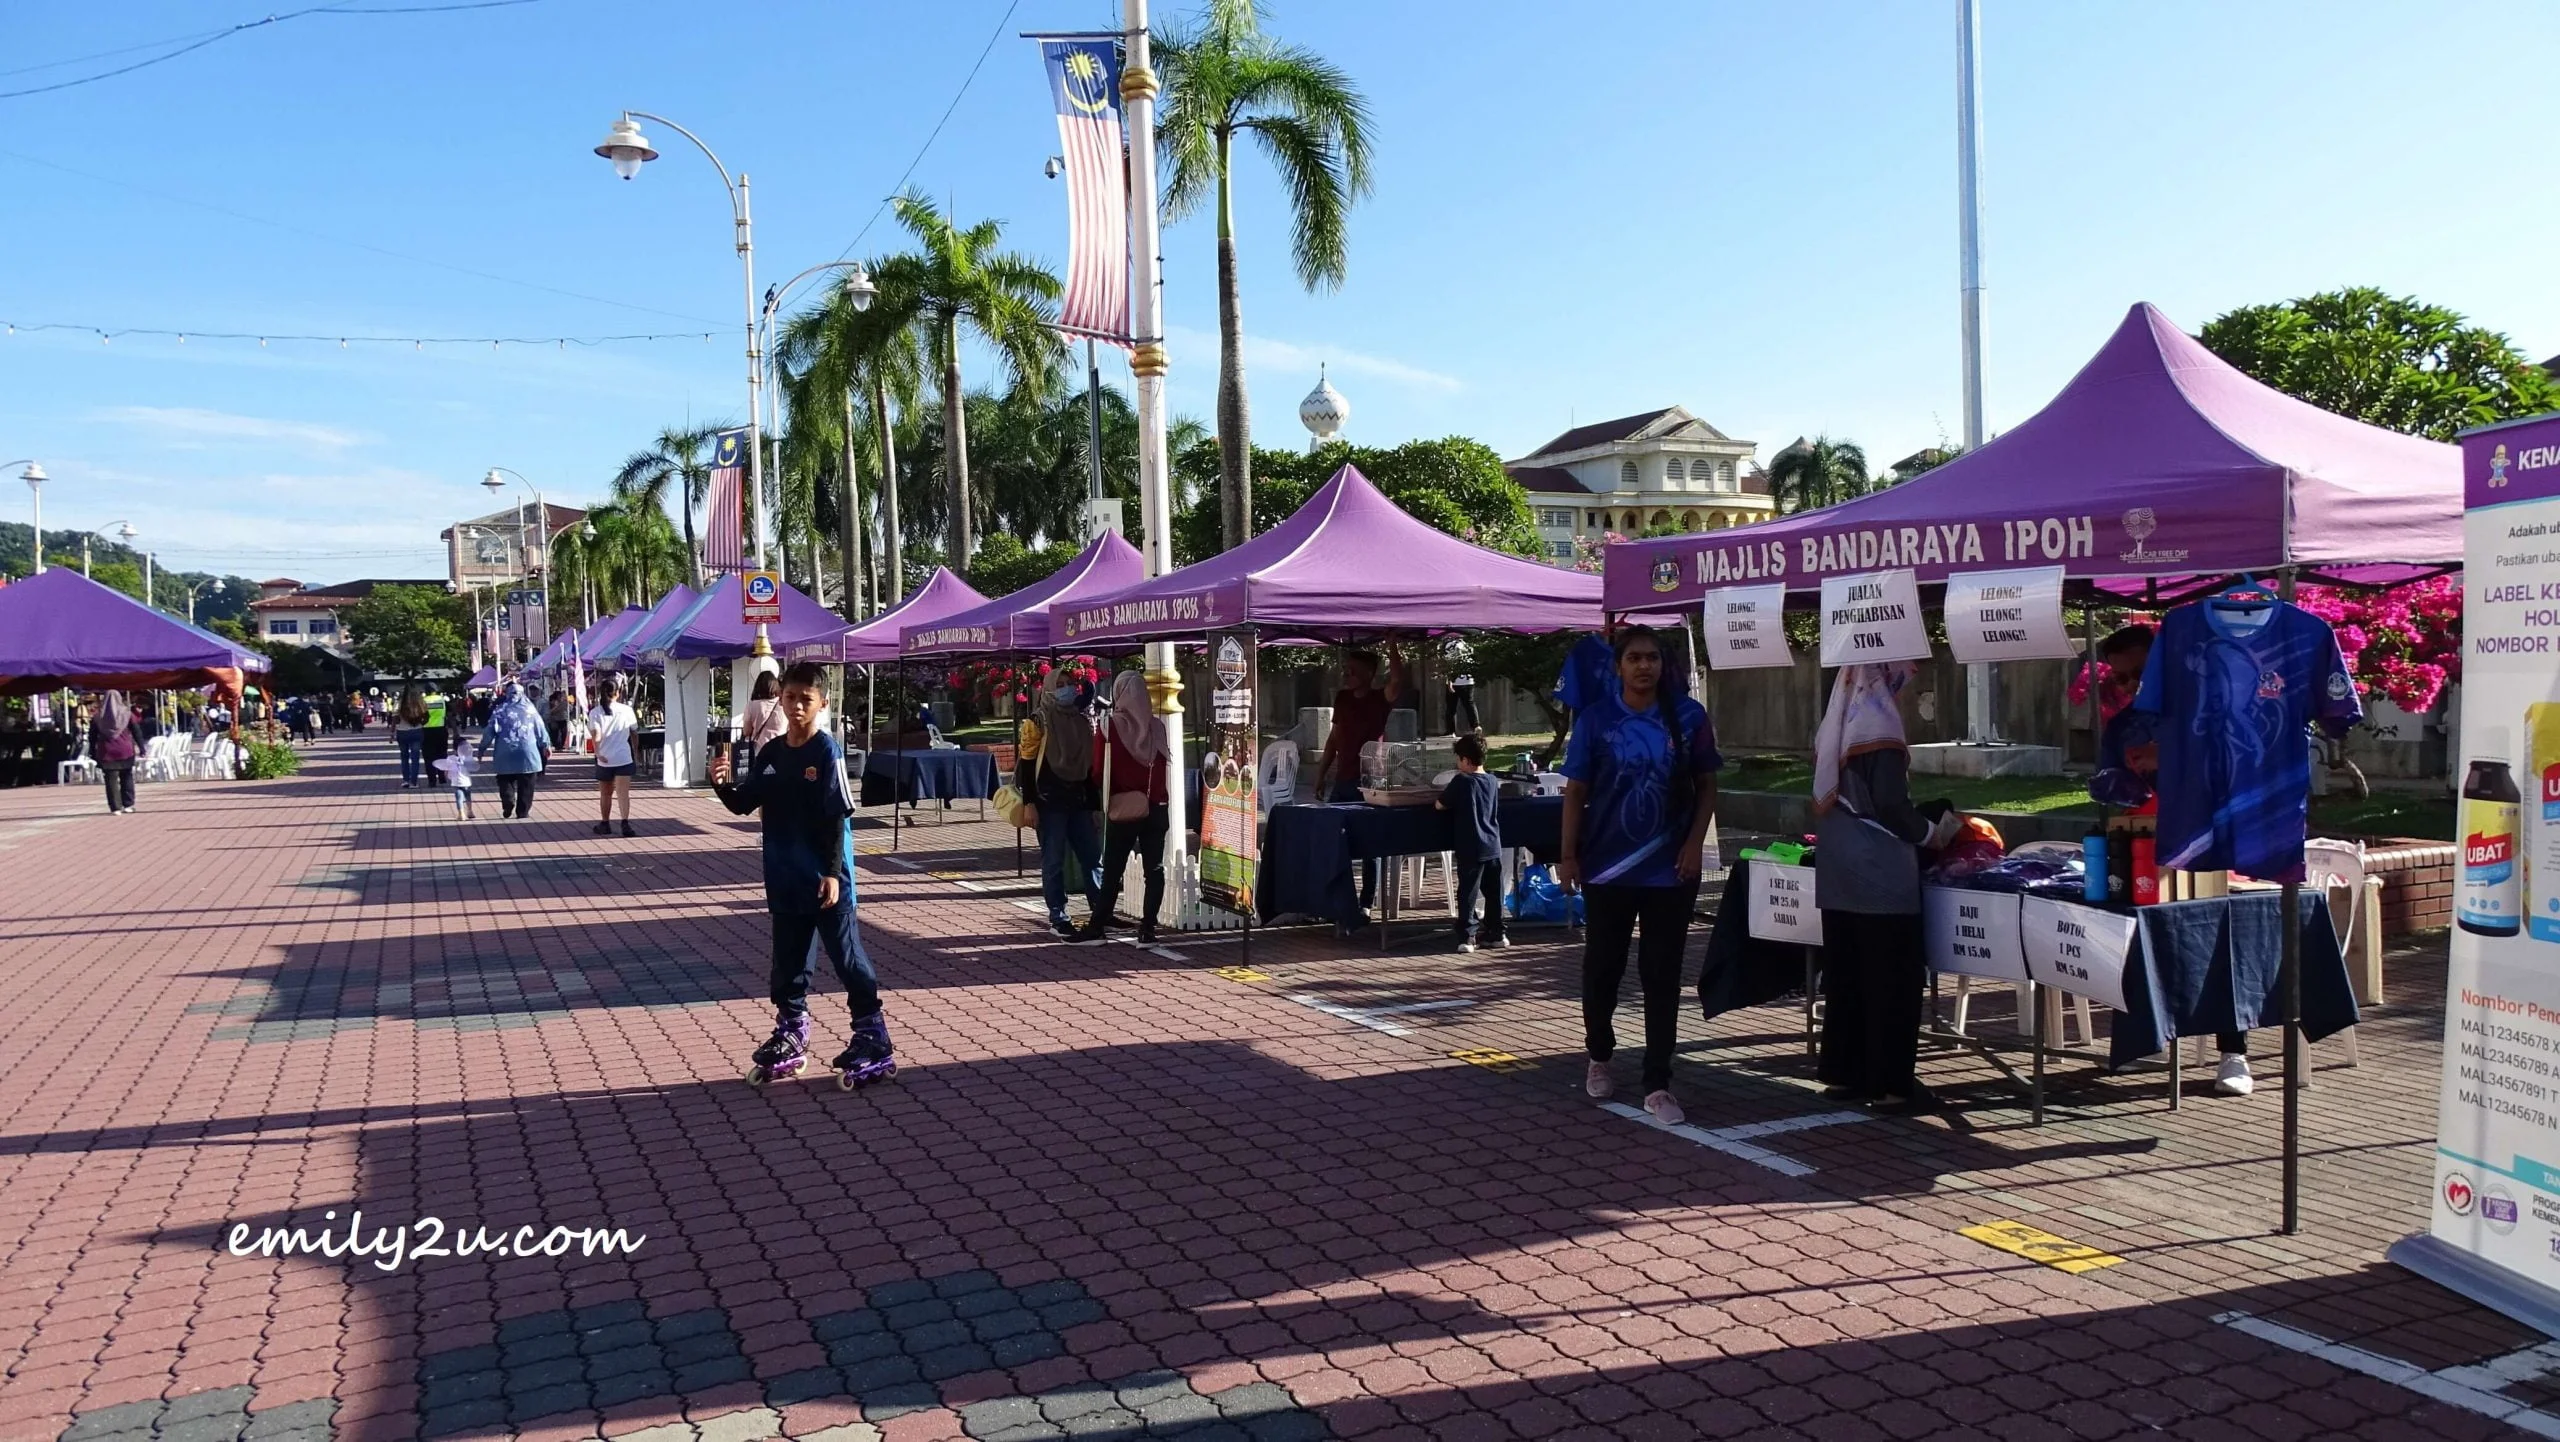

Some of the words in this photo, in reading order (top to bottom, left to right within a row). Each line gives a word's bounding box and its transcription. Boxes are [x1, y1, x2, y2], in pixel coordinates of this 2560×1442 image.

[2508, 524, 2546, 538] Adakah
[1696, 545, 1786, 585] MAJLIS
[1801, 523, 1984, 573] BANDARAYA
[2003, 516, 2094, 561] IPOH
[2174, 549, 2189, 557] DAY
[2496, 552, 2539, 567] Pastikan
[753, 580, 764, 593] P
[1847, 583, 1882, 604] JUALAN
[1980, 586, 2022, 601] LELONG!!
[2484, 584, 2535, 604] LABEL
[1079, 607, 1110, 632] MAJLIS
[1113, 599, 1169, 626] BANDARAYA
[1172, 596, 1199, 620] IPOH
[1727, 601, 1756, 614] LELONG!!
[1831, 603, 1906, 625] PENGHABISAN
[1980, 608, 2022, 622] LELONG!!
[1727, 620, 1756, 632] LELONG!!
[1730, 638, 1760, 650] LELONG!!
[1853, 632, 1885, 649] STOK
[1982, 629, 2028, 643] LELONG!!
[2476, 636, 2549, 654] NOMBOR
[2467, 842, 2505, 864] UBAT
[1774, 878, 1785, 890] SET
[1769, 895, 1780, 906] RM
[1780, 896, 1800, 909] 25.00
[1959, 905, 1979, 919] BAJU
[1955, 925, 1959, 937] 1
[1961, 925, 1985, 940] HELAI
[2056, 919, 2087, 939] BOTOL
[1952, 943, 1967, 956] RM
[1967, 945, 1991, 960] 15.00
[2059, 942, 2063, 954] 1
[2065, 943, 2082, 959] PCS
[2055, 960, 2068, 974] RM
[2069, 962, 2088, 981] 5.00
[2461, 989, 2523, 1015] Nombor
[2461, 1019, 2549, 1051] MAL12345678
[2461, 1042, 2549, 1075] MAL23456789
[2460, 1065, 2546, 1100] MAL34567891
[2459, 1089, 2545, 1126] MAL12345678
